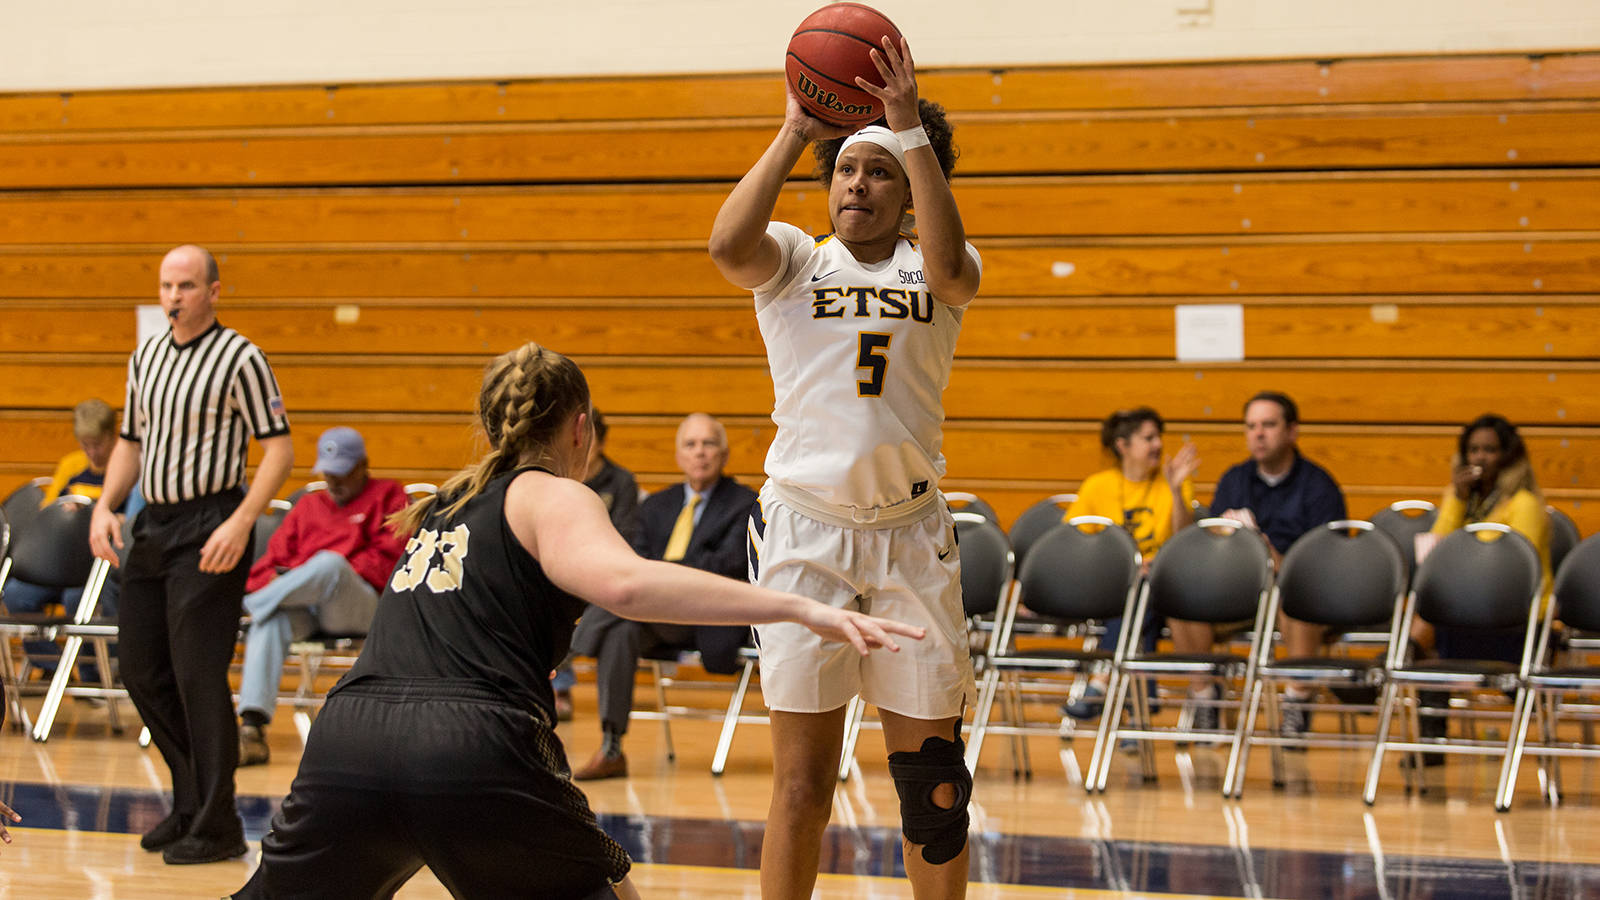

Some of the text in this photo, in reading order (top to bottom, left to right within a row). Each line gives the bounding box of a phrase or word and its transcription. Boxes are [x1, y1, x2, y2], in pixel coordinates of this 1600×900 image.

[799, 71, 873, 115] Wilson
[812, 287, 934, 324] ETSU
[856, 331, 893, 398] 5
[390, 523, 470, 593] 33
